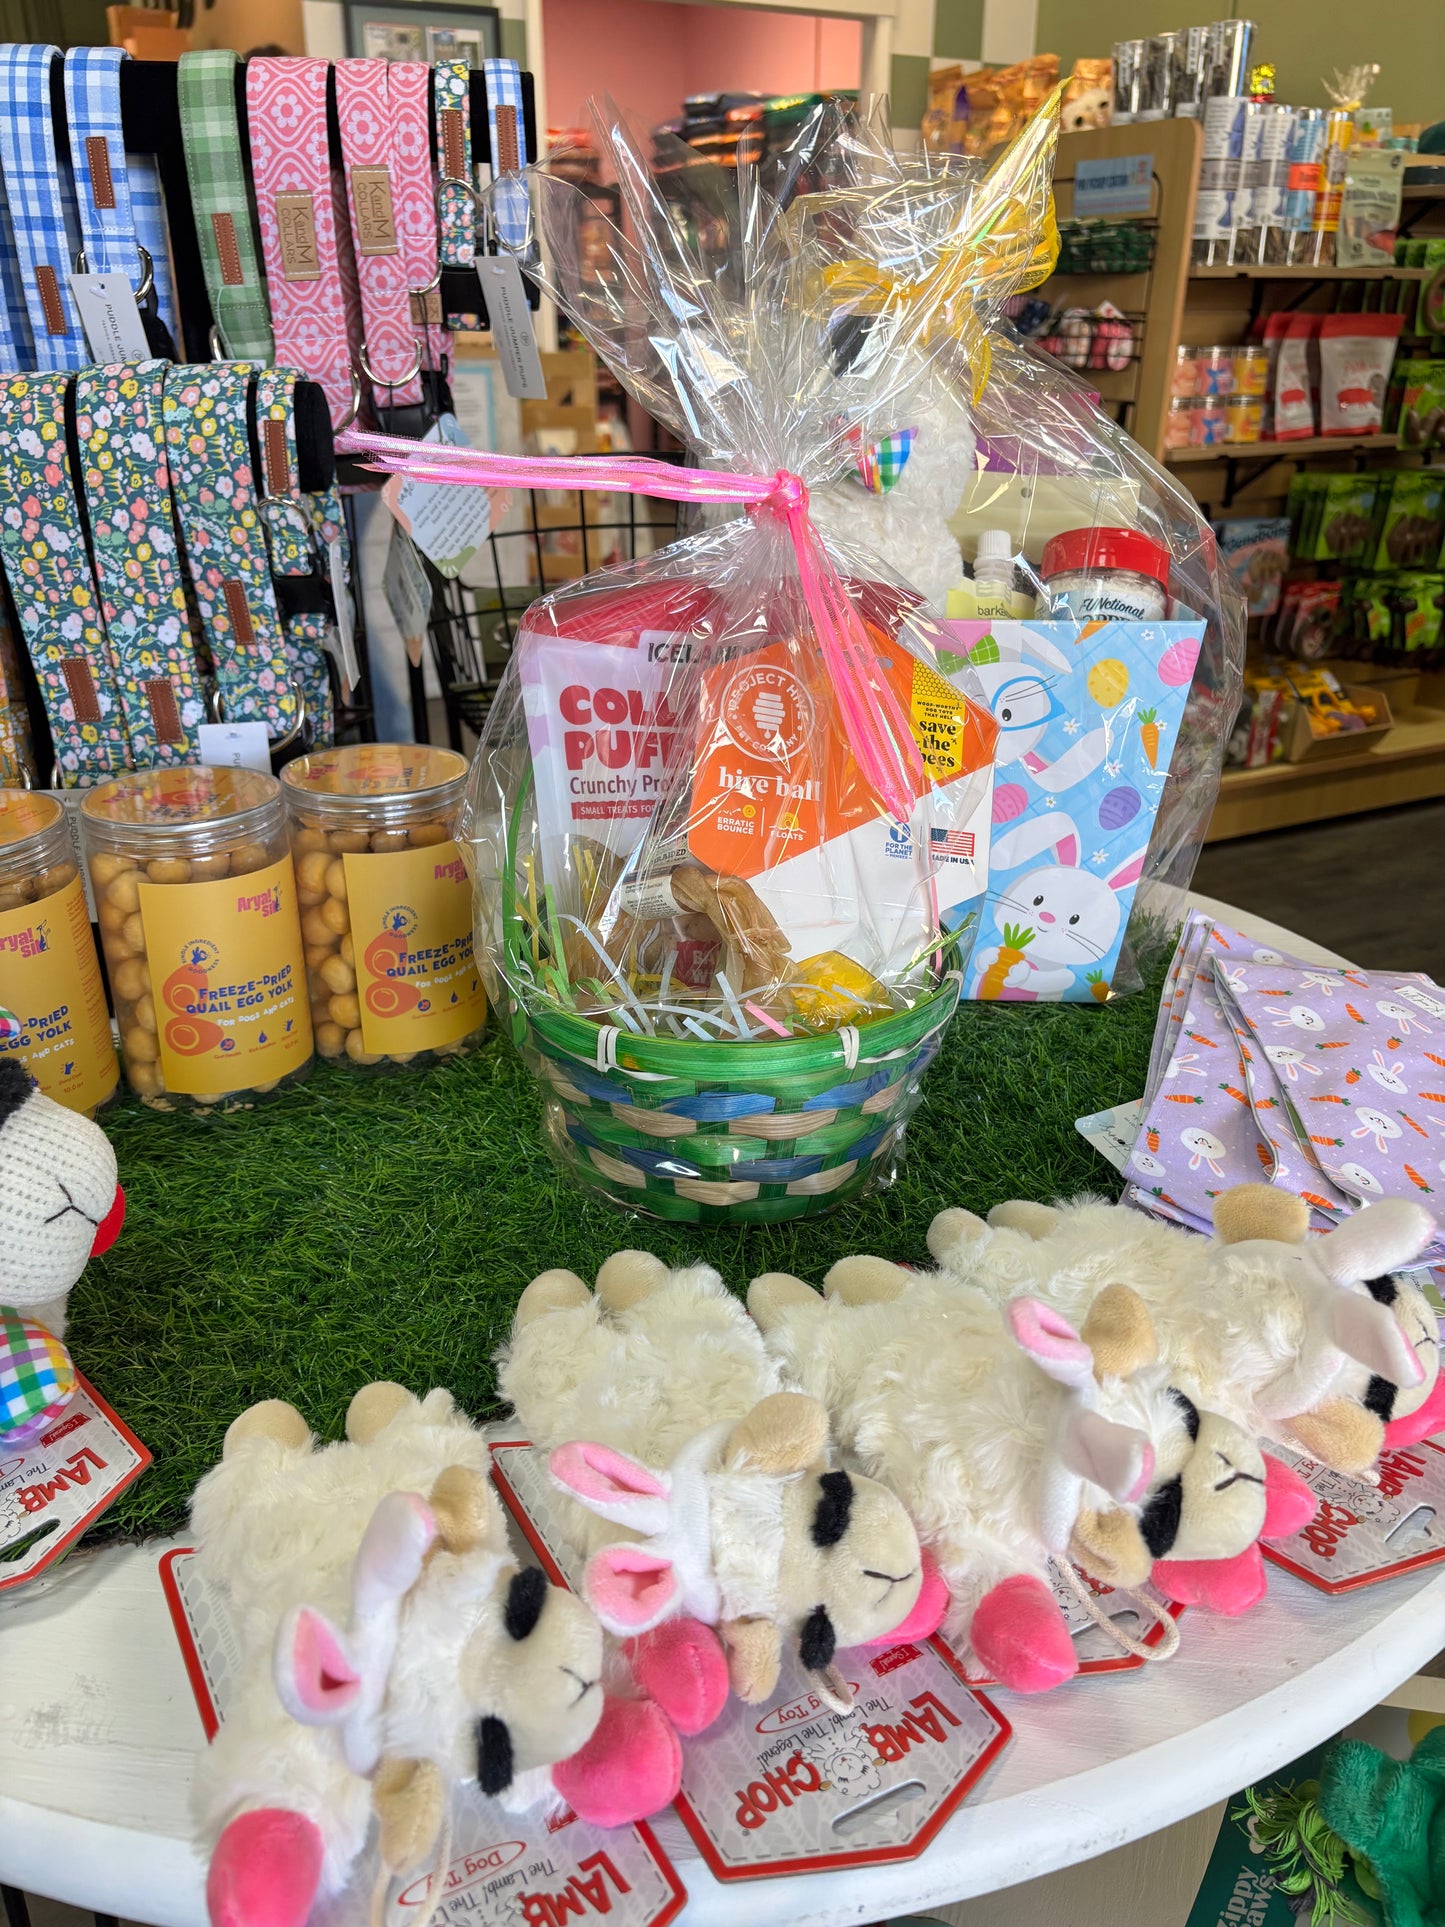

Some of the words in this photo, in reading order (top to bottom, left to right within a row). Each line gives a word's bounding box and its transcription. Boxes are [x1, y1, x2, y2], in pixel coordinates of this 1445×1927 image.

[357, 182, 373, 239] COLLARS
[280, 208, 297, 264] COLLARS
[105, 303, 121, 341] PUDDLE
[728, 672, 786, 712] PROJECT
[919, 720, 957, 736] save
[922, 734, 951, 752] the
[569, 775, 637, 797] Crunchy
[718, 766, 769, 794] hive
[775, 776, 822, 801] ball
[580, 806, 605, 815] SMALL
[607, 804, 638, 815] TREATS
[717, 816, 755, 828] ERRATIC
[69, 815, 81, 851] PUDDLE
[716, 824, 754, 835] BOUNCE
[770, 830, 804, 841] FLOATS
[885, 847, 913, 856] PLANET
[931, 855, 950, 863] ADE
[237, 888, 272, 913] Arya!
[0, 927, 33, 953] rya!
[398, 931, 474, 964] FREEZE-DRIE
[386, 965, 428, 977] QUAIL
[432, 956, 456, 972] EGG
[198, 964, 292, 1001] FREEZE-DRIED
[185, 1001, 232, 1014] QUAIL
[237, 992, 264, 1009] EGG
[268, 979, 293, 999] YOLK
[216, 1018, 235, 1027] FOR
[238, 1012, 260, 1023] DOGS
[263, 1004, 278, 1016] AND
[279, 997, 294, 1009] CATS
[0, 1034, 32, 1052] EGG
[37, 1020, 72, 1042] YOLK
[32, 1048, 51, 1060] AND
[53, 1038, 75, 1052] CATS
[16, 1446, 109, 1513] LAMB
[26, 1462, 52, 1477] The
[0, 1475, 26, 1492] Lam
[1299, 1499, 1359, 1557] CHOP
[777, 1704, 810, 1724] Toy
[865, 1696, 894, 1712] The
[801, 1722, 830, 1739] The
[860, 1690, 963, 1762] LAMB
[757, 1733, 806, 1772] Legend!
[735, 1749, 822, 1830] CHOP
[464, 1849, 504, 1877] Dog
[529, 1857, 559, 1879] The
[484, 1869, 529, 1907] Lamb!
[517, 1849, 632, 1927] LAMB
[454, 1889, 481, 1915] The
